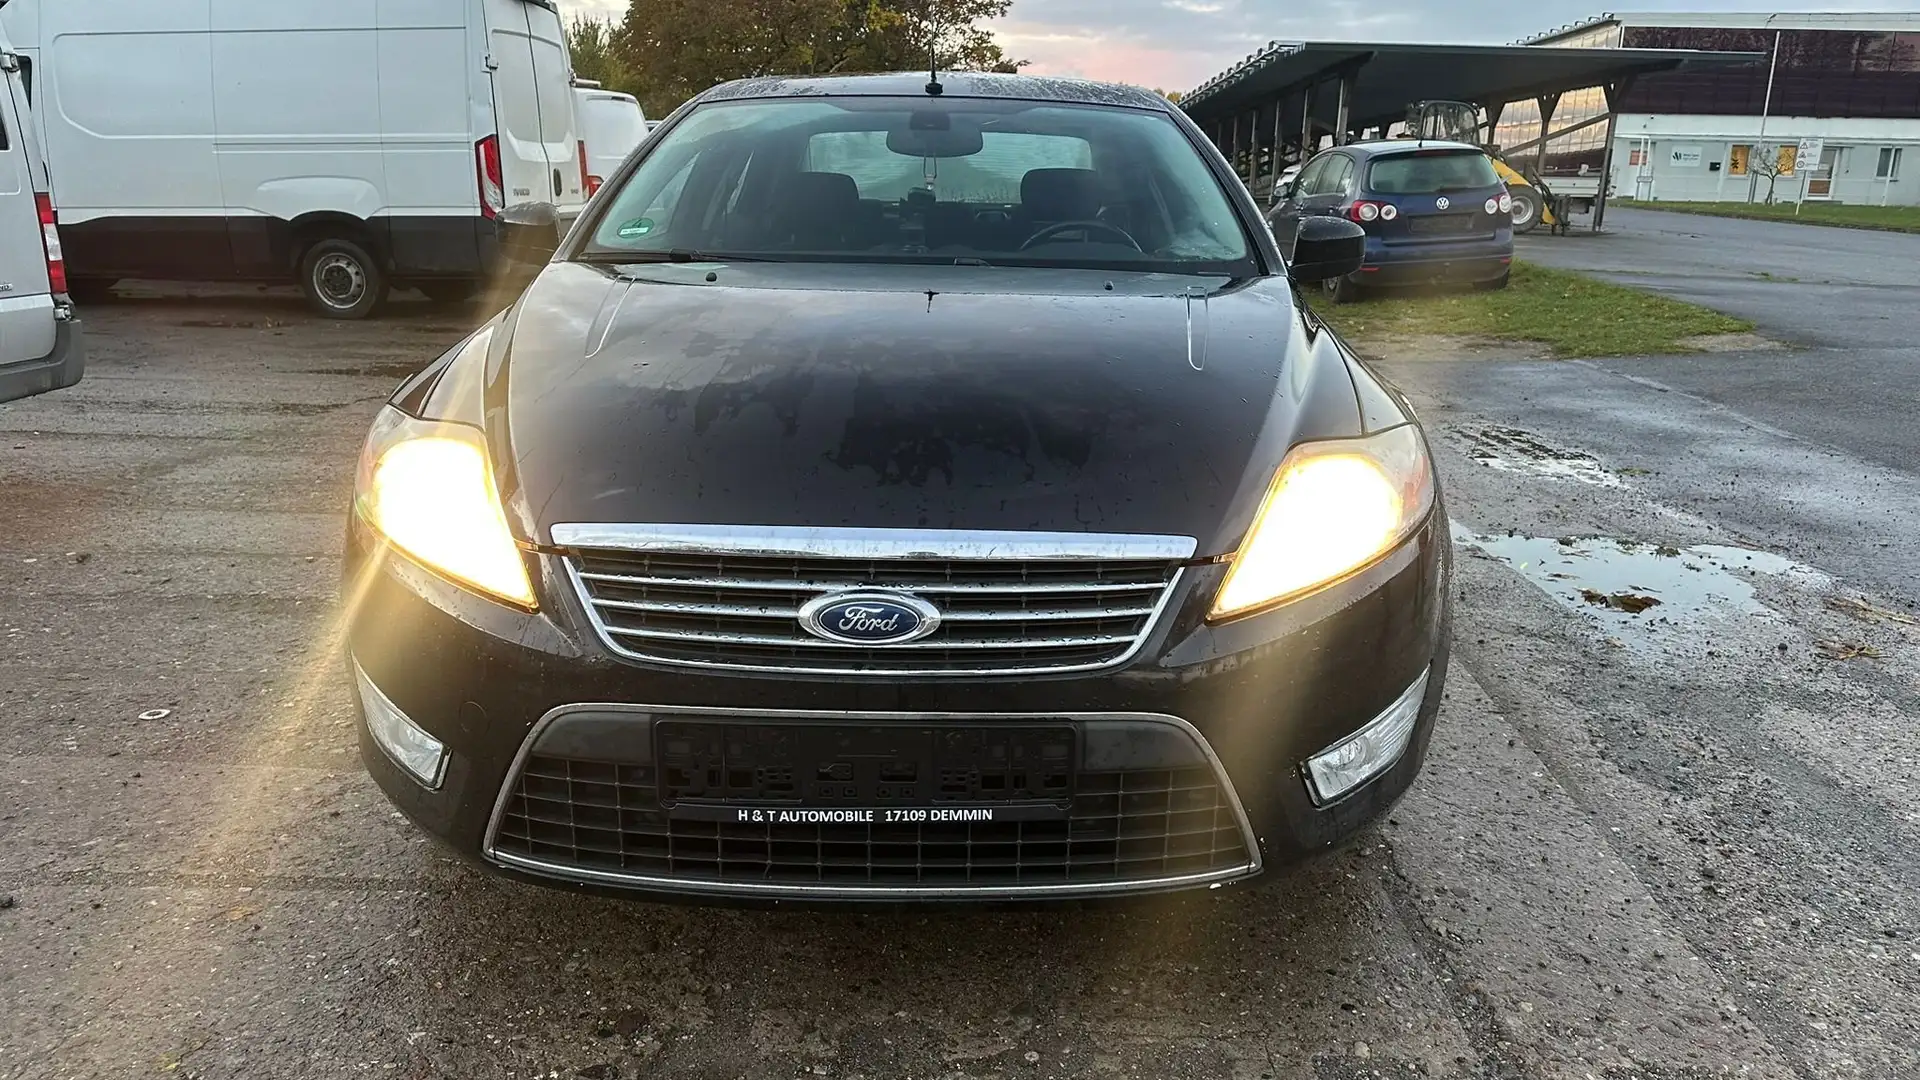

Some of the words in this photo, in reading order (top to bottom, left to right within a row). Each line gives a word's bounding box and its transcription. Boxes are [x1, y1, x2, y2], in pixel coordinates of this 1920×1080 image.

[839, 606, 899, 631] Ford
[738, 810, 748, 821] H
[752, 810, 764, 822] &
[767, 810, 777, 822] T
[779, 810, 874, 822] AUTOMOBILE
[885, 810, 927, 821] 17109
[930, 809, 993, 821] DEMMIN
